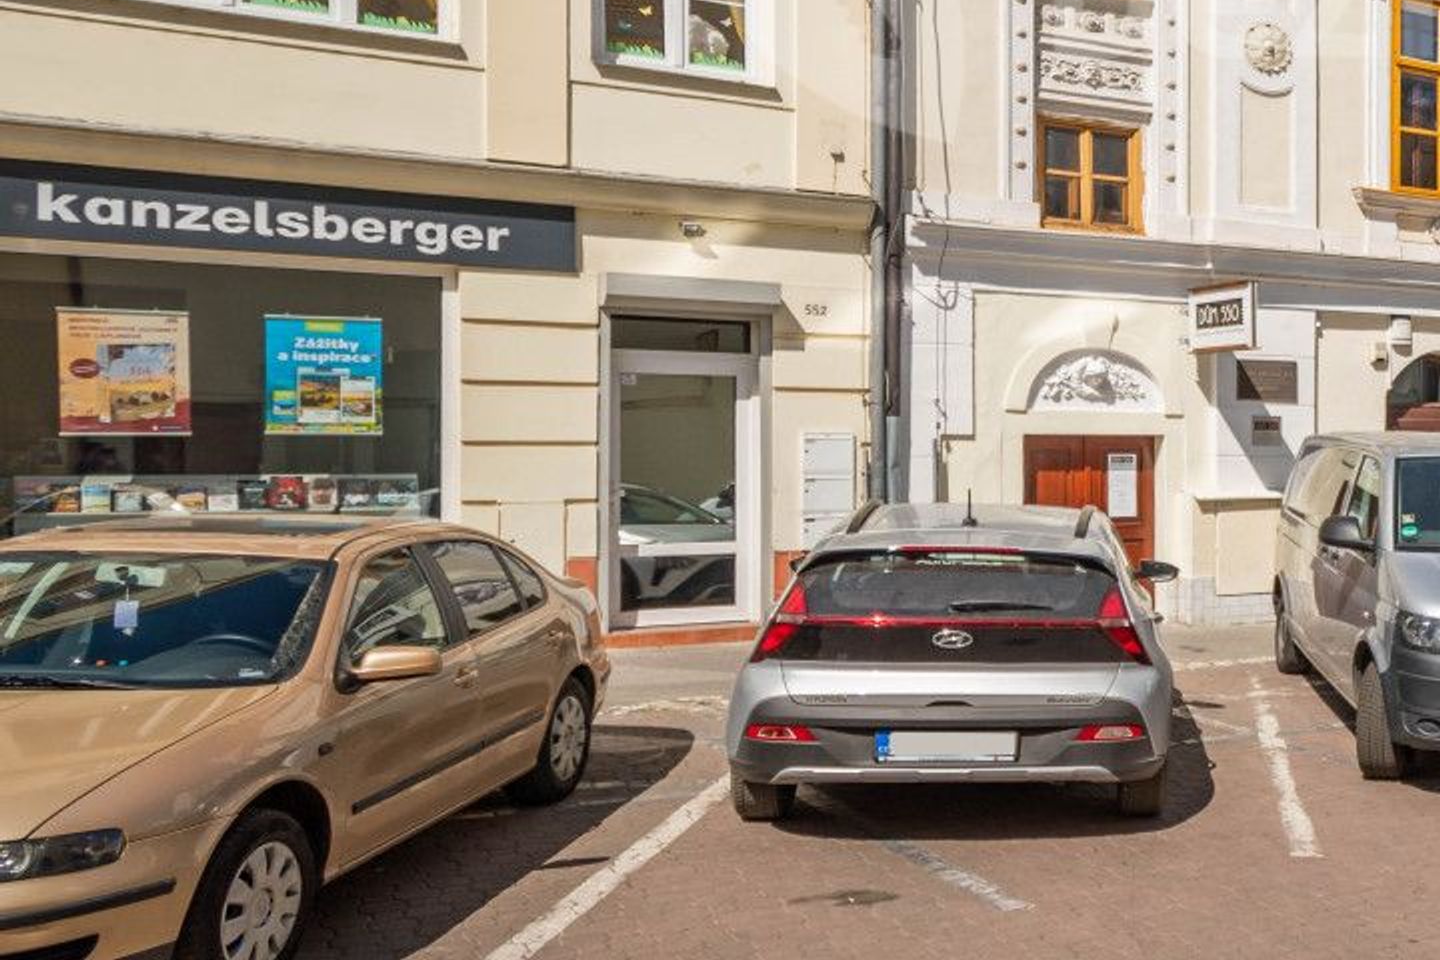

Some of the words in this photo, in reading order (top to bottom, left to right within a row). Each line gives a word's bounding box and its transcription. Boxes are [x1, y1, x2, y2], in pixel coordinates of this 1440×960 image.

[36, 181, 511, 256] kanzelsberger
[294, 336, 359, 355] Zážitky
[292, 349, 371, 365] inspirace
